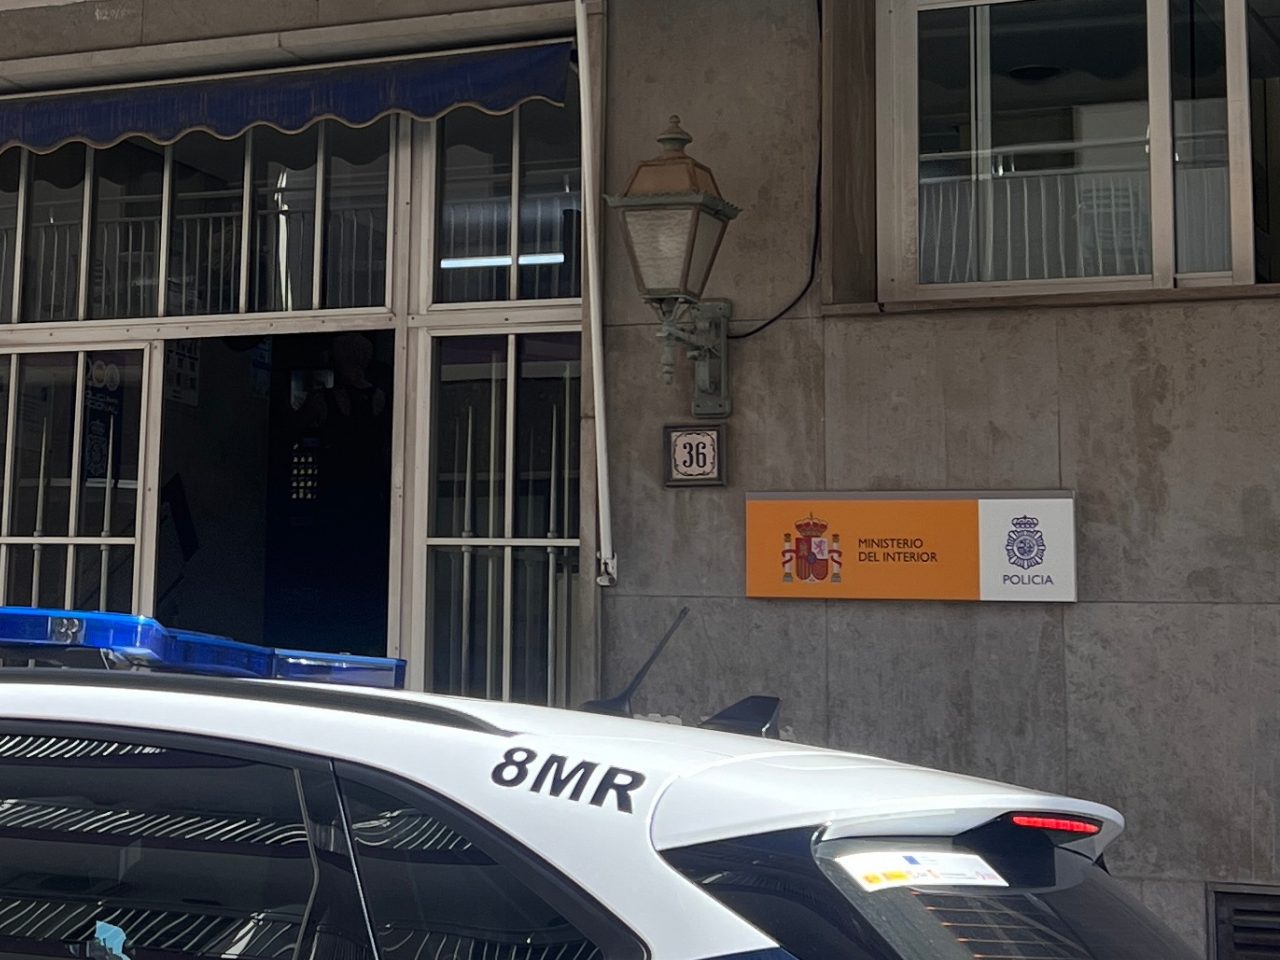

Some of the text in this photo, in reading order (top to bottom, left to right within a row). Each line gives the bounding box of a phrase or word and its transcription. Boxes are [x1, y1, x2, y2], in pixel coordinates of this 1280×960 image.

[682, 441, 707, 468] 36
[858, 538, 924, 549] MINISTERIO
[858, 551, 938, 562] DEL INTERIOR
[1003, 573, 1054, 586] POLICIA
[491, 747, 647, 814] 8MR
